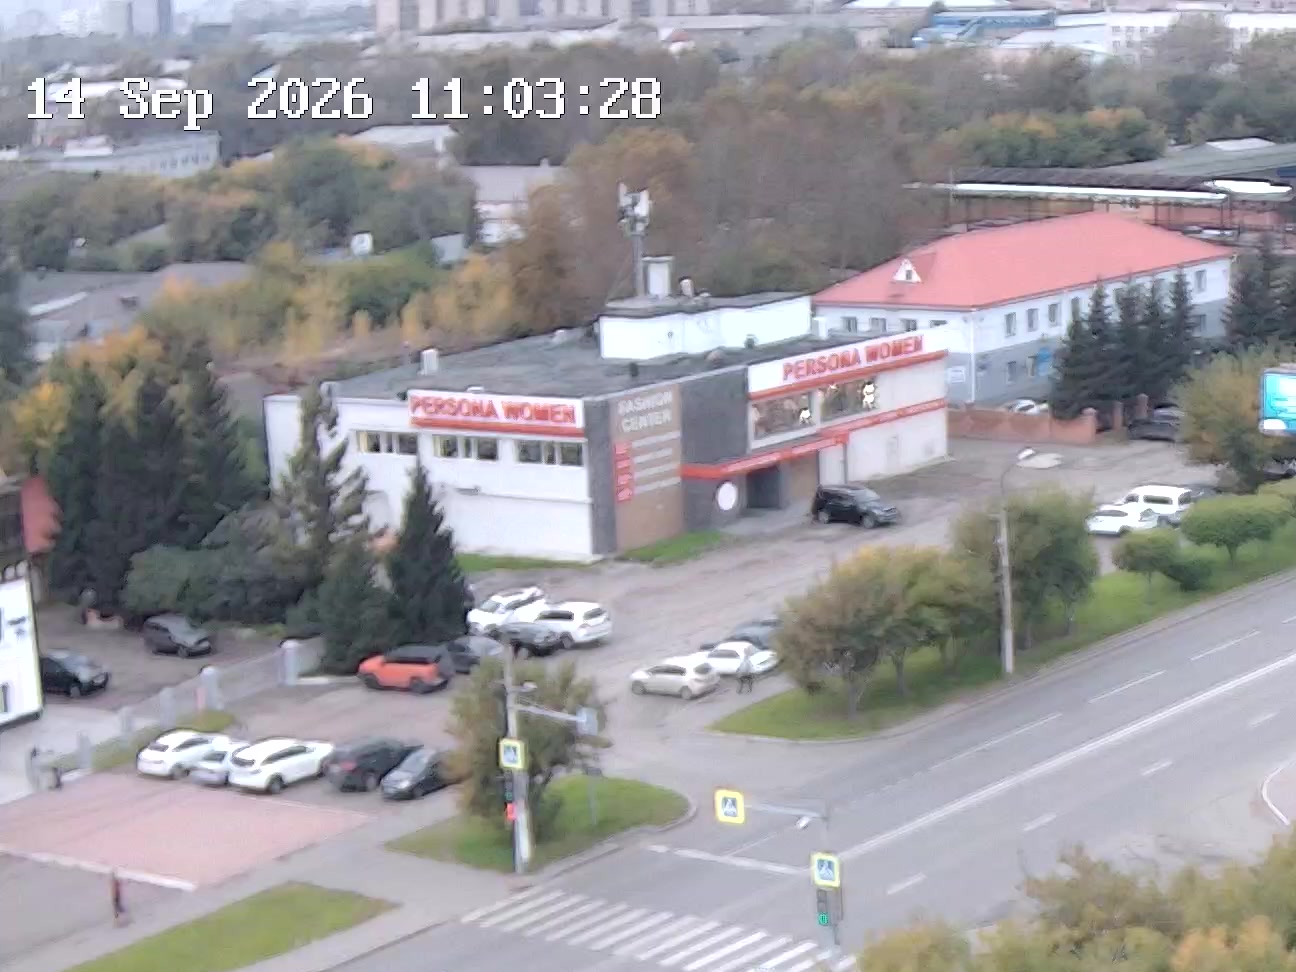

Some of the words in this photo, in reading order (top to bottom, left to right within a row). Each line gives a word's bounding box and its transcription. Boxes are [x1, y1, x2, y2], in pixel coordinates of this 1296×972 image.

[783, 348, 861, 380] PERSONA
[865, 336, 924, 362] WOMEN
[410, 396, 498, 419] PERSONA
[501, 400, 576, 424] WOMEN
